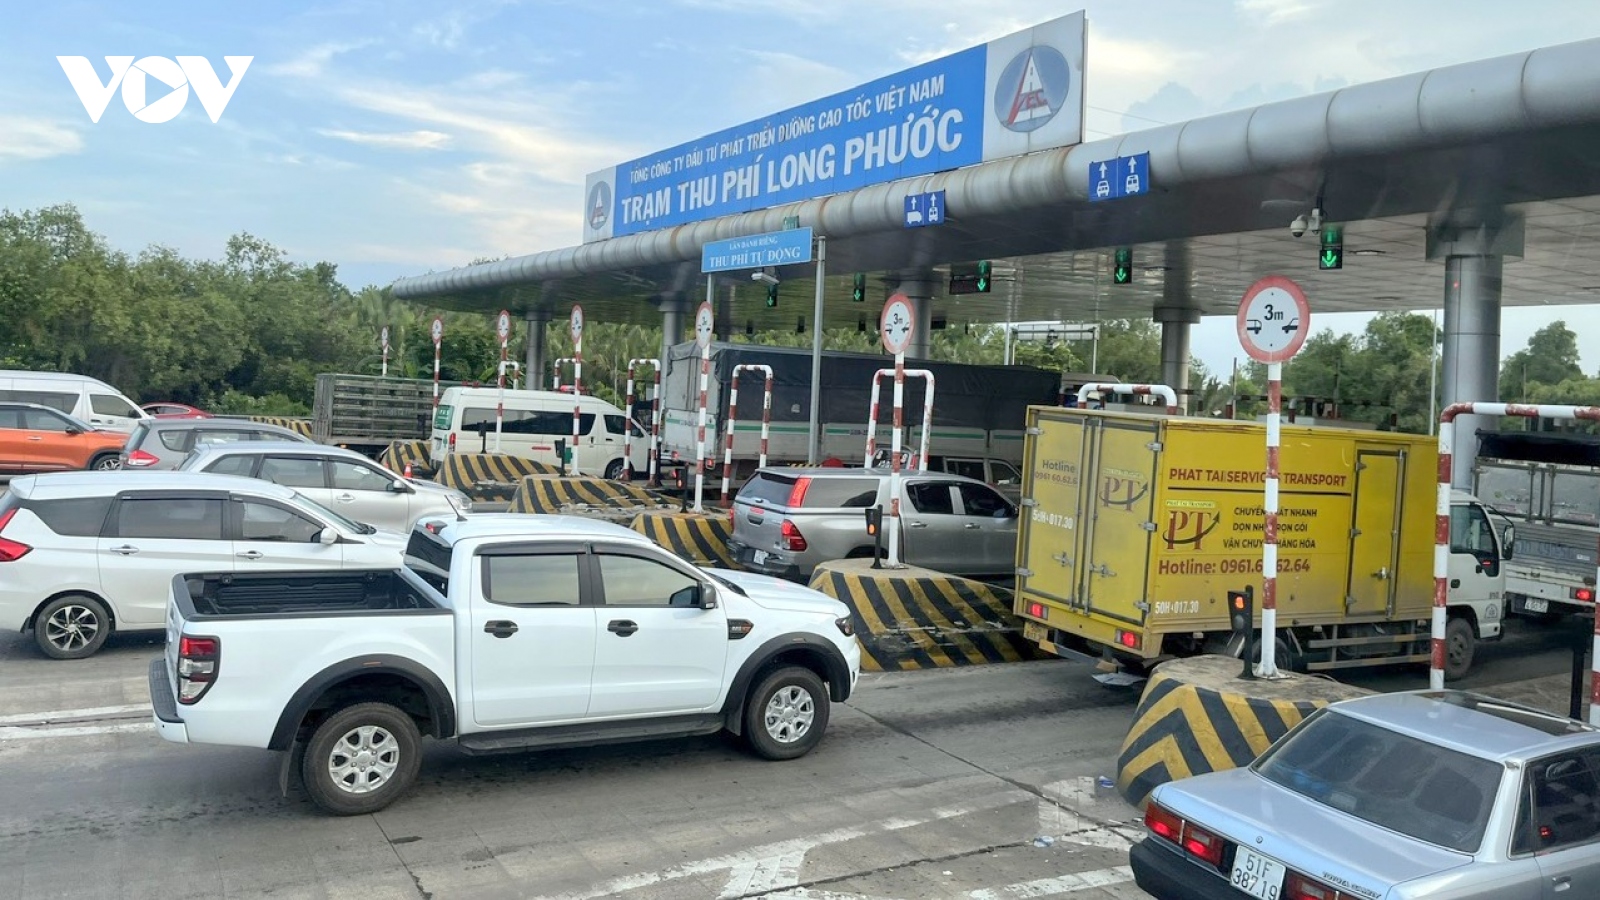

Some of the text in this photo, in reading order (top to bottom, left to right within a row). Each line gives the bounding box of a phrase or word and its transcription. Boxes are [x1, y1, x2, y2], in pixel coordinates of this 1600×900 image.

[650, 160, 672, 179] CÔNG
[674, 155, 685, 172] TY
[705, 142, 718, 163] TƯ
[818, 107, 842, 130] CAO
[846, 93, 871, 122] TỐC
[875, 85, 906, 115] VIỆT
[909, 74, 945, 103] NAM
[621, 104, 963, 225] TRẠM THU PHÍ LONG PHƯỚC
[710, 245, 801, 268] THU PHÍ TỰ ĐỘNG
[893, 313, 903, 325] 3m
[1264, 304, 1284, 321] 3m
[1042, 459, 1076, 474] Hotline
[1169, 468, 1347, 487] PHAT TAI SERVIC TRANSPORT
[1102, 475, 1141, 512] PT
[1290, 508, 1317, 517] NHANH
[1167, 510, 1212, 551] PT
[1233, 522, 1308, 534] DỌN NH RỌN GÓI
[1223, 537, 1239, 551] VẬN
[1241, 538, 1265, 549] CHUY
[1158, 558, 1310, 575] Hotline: 0961.662.64
[1246, 854, 1273, 878] 51F
[1232, 867, 1278, 900] 387.19
